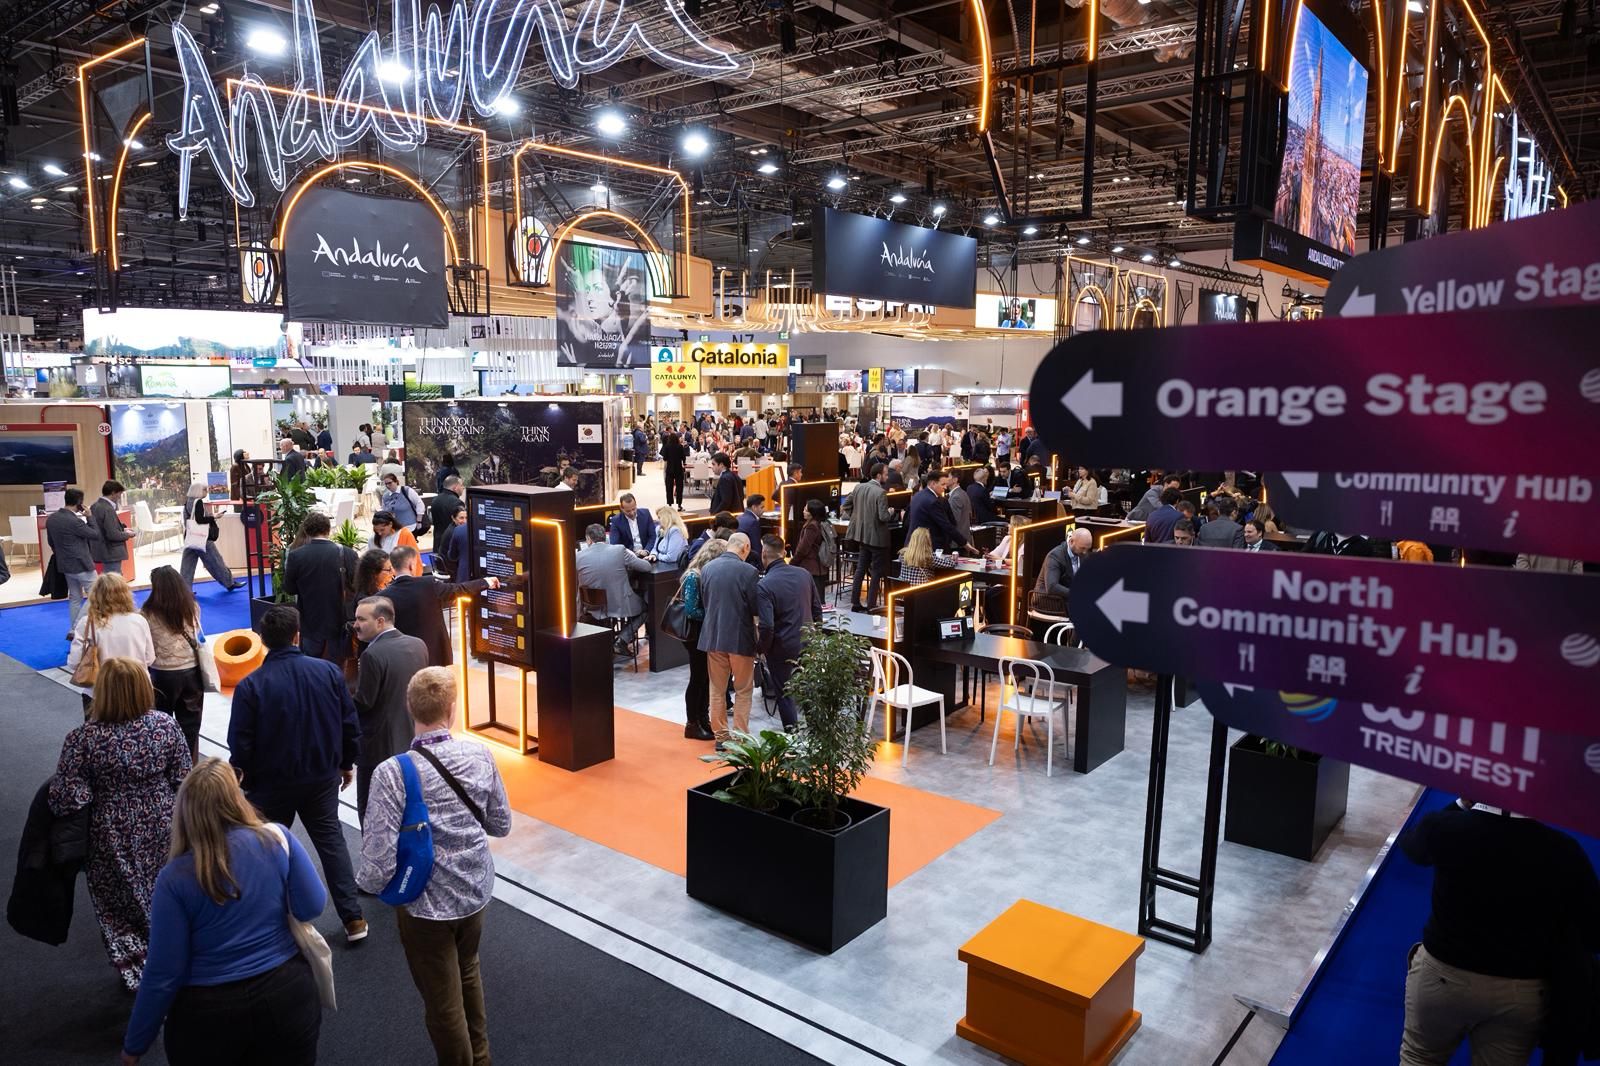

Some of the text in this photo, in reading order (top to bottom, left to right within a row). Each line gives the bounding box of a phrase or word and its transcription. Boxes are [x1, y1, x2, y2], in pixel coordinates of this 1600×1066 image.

[311, 232, 428, 274] Andalucía
[880, 241, 935, 273] Andalucía
[1401, 279, 1505, 315] Yellow
[691, 347, 777, 365] Catalonia
[1156, 373, 1548, 426] Orange Stage
[99, 425, 110, 433] 38
[419, 417, 474, 426] THINK YOU
[419, 425, 485, 435] KNOW SPAIN?
[520, 426, 549, 435] THINK
[520, 434, 550, 443] AGAIN
[1335, 472, 1593, 504] Community Hub
[961, 590, 969, 602] 29
[1272, 569, 1394, 609] North
[1172, 597, 1518, 663] Community Hub
[1359, 726, 1535, 793] TRENDFEST
[399, 866, 413, 893] THETFORD
